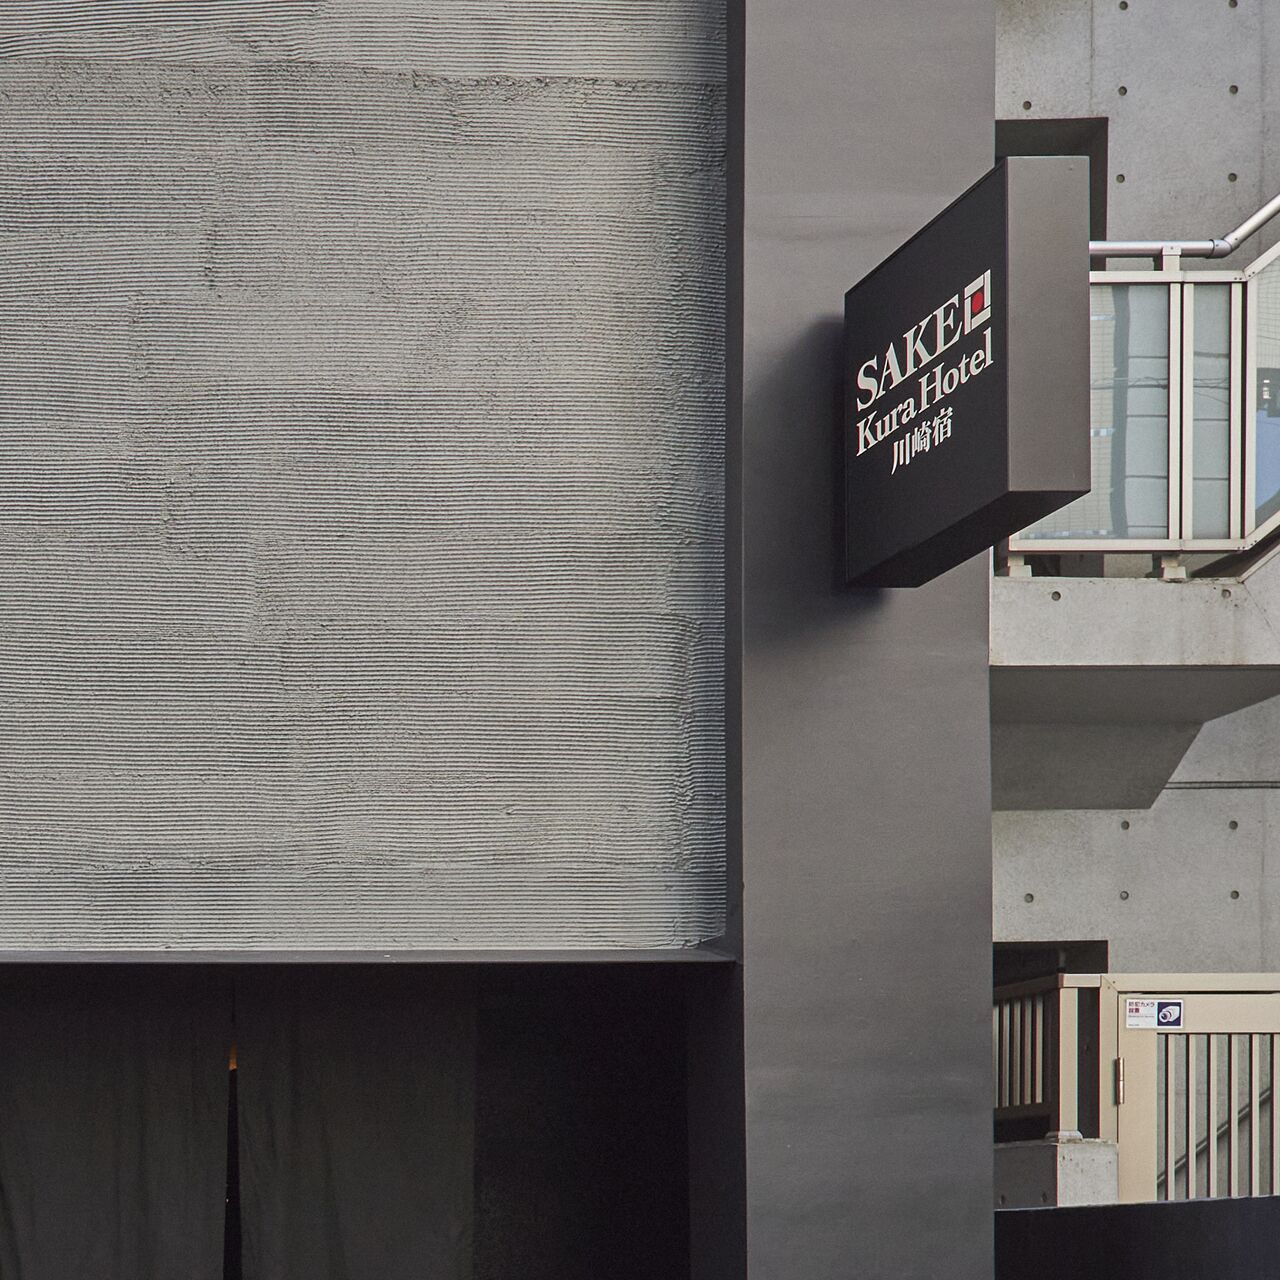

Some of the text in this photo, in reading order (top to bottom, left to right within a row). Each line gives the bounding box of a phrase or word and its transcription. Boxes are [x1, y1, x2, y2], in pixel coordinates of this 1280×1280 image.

[856, 294, 963, 412] SAKE
[856, 326, 994, 457] Kura Hotel
[891, 407, 954, 475] 川崎宿
